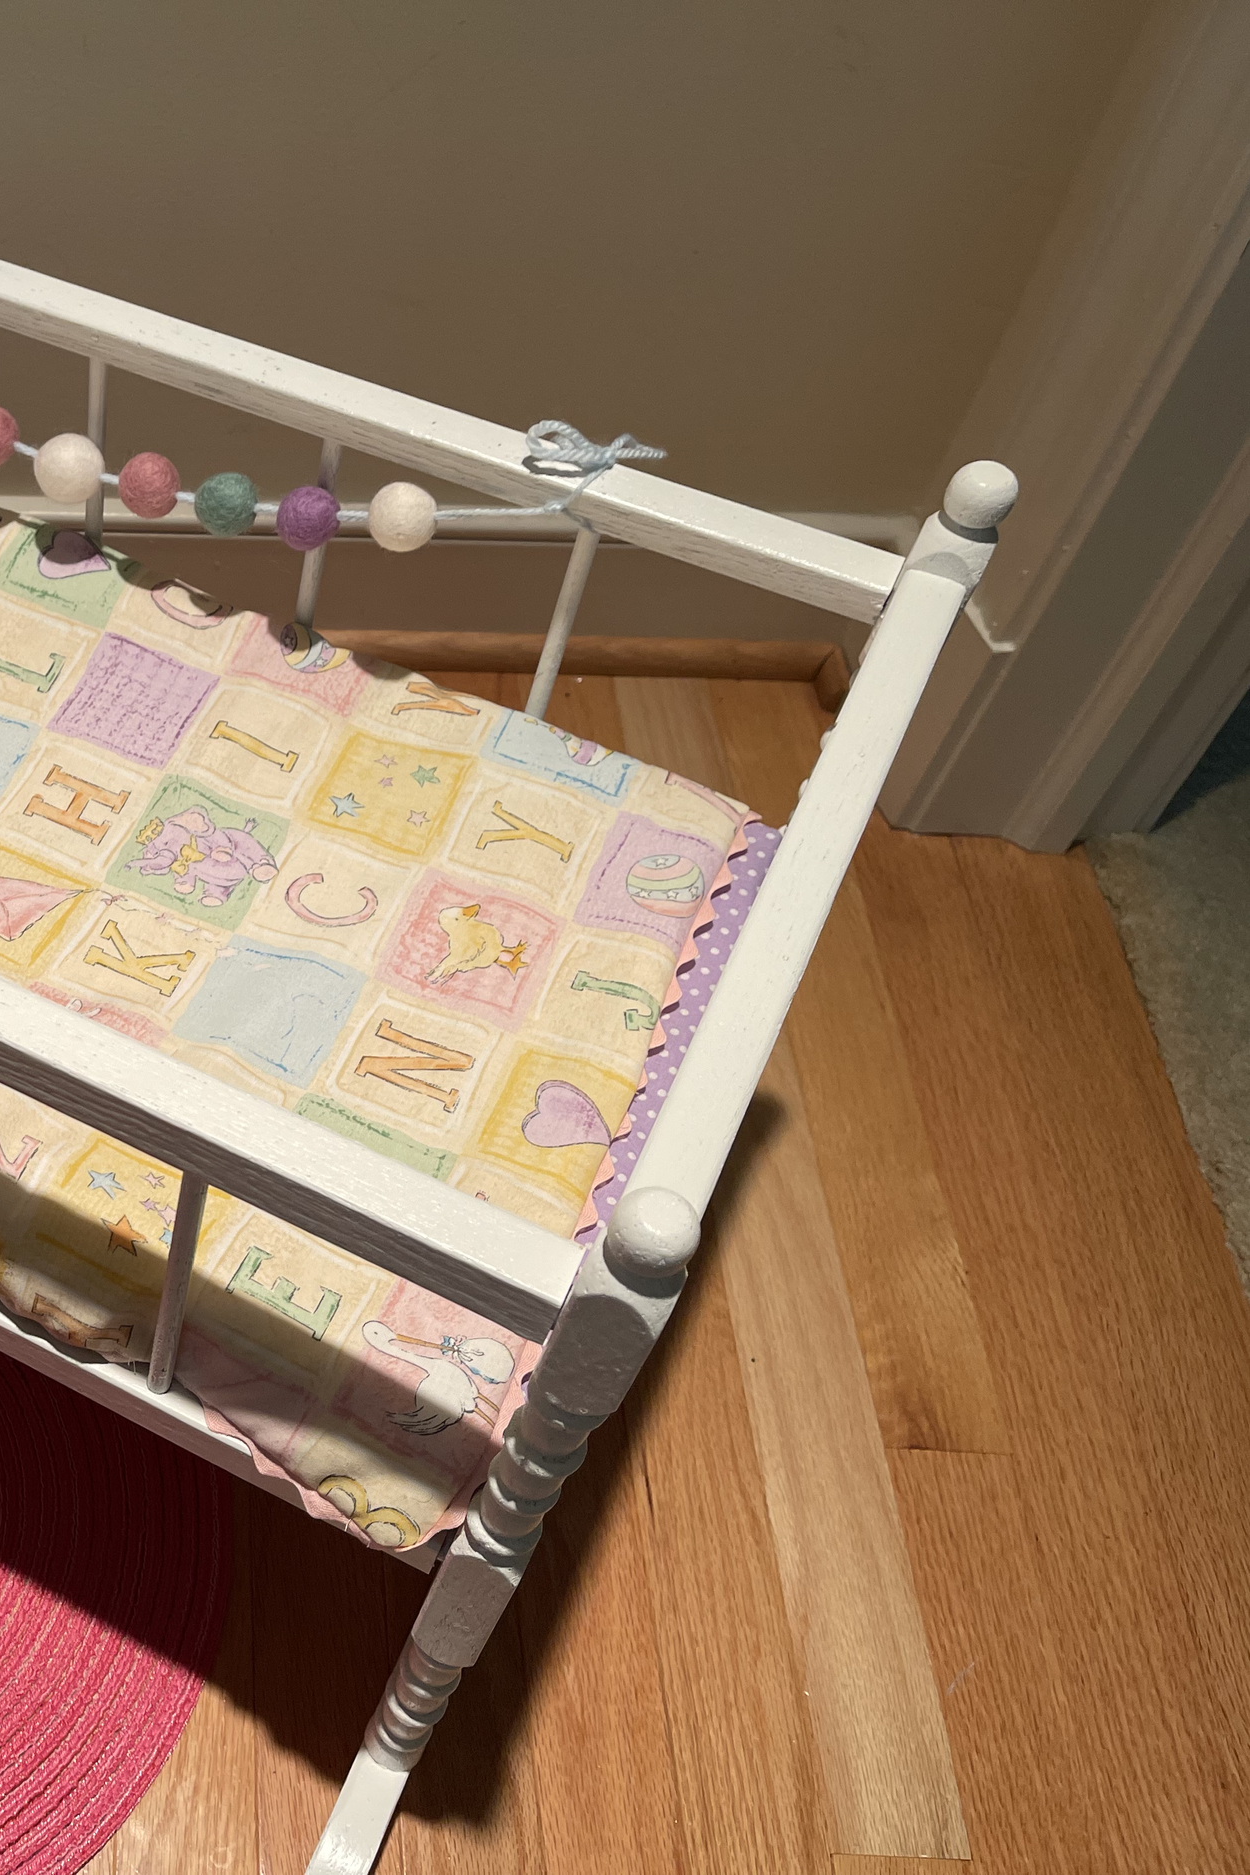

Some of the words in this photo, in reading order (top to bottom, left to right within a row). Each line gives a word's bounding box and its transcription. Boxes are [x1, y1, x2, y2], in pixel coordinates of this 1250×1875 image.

[210, 720, 300, 773] I
[23, 764, 132, 846] H
[475, 800, 576, 864] Y
[285, 873, 378, 927] C
[83, 919, 196, 997] K
[571, 970, 662, 1031] J
[354, 1018, 475, 1113] N
[225, 1245, 343, 1341] E
